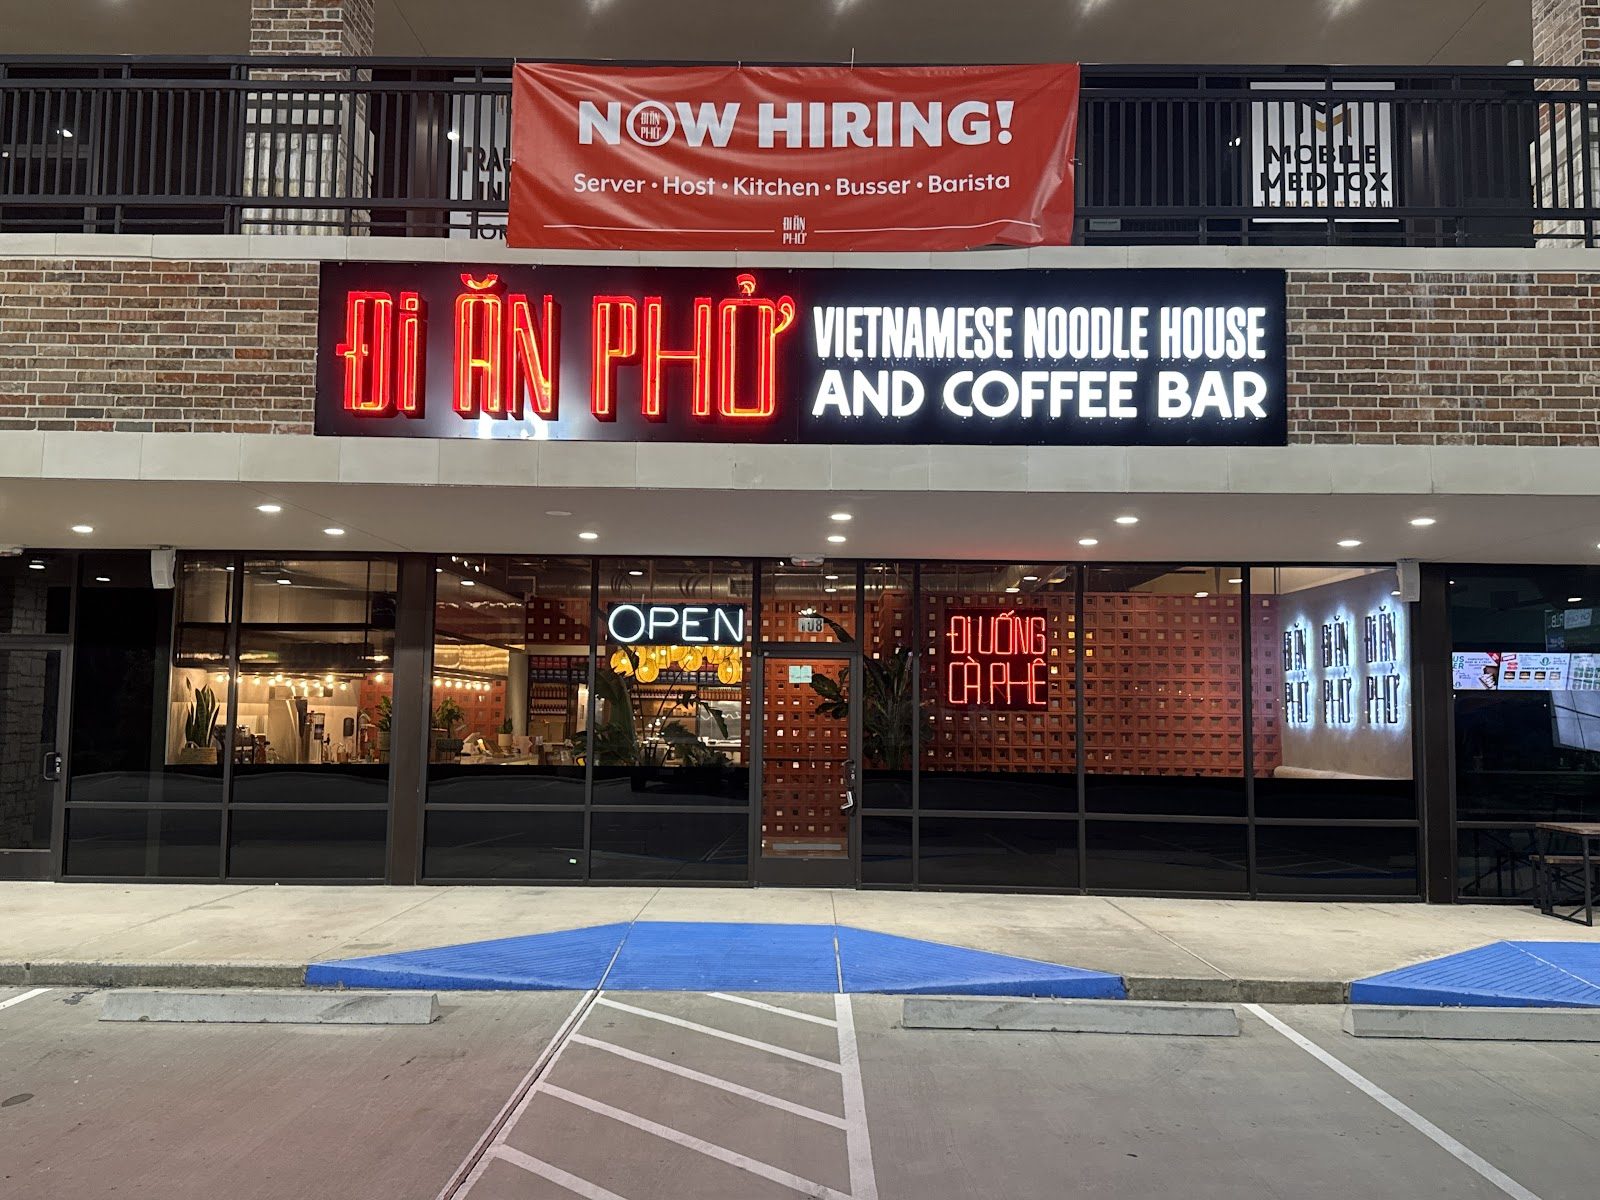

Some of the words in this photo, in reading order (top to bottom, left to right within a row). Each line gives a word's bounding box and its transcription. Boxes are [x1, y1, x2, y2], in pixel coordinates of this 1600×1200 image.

[578, 100, 741, 148] NOW
[758, 100, 1015, 149] HIRING!
[1265, 144, 1377, 164] MOBILE
[573, 173, 646, 193] Server
[663, 176, 716, 196] Host
[733, 177, 820, 197] Kitchen
[836, 178, 911, 197] Busser
[928, 173, 1011, 194] Barista
[1260, 172, 1389, 191] MEDTOX
[452, 272, 558, 420] ĂN
[591, 273, 796, 420] PHỞ
[812, 306, 1014, 359] VIETNAMESE
[1023, 306, 1149, 360] NOODLE
[1160, 306, 1267, 360] HOUSE
[811, 369, 925, 417] AND
[943, 370, 1138, 418] COFFEE
[1157, 371, 1268, 418] BAR
[608, 604, 744, 643] OPEN
[978, 609, 1046, 655] UỐNG
[949, 655, 981, 705] CÀ
[990, 657, 1047, 705] PHÊ
